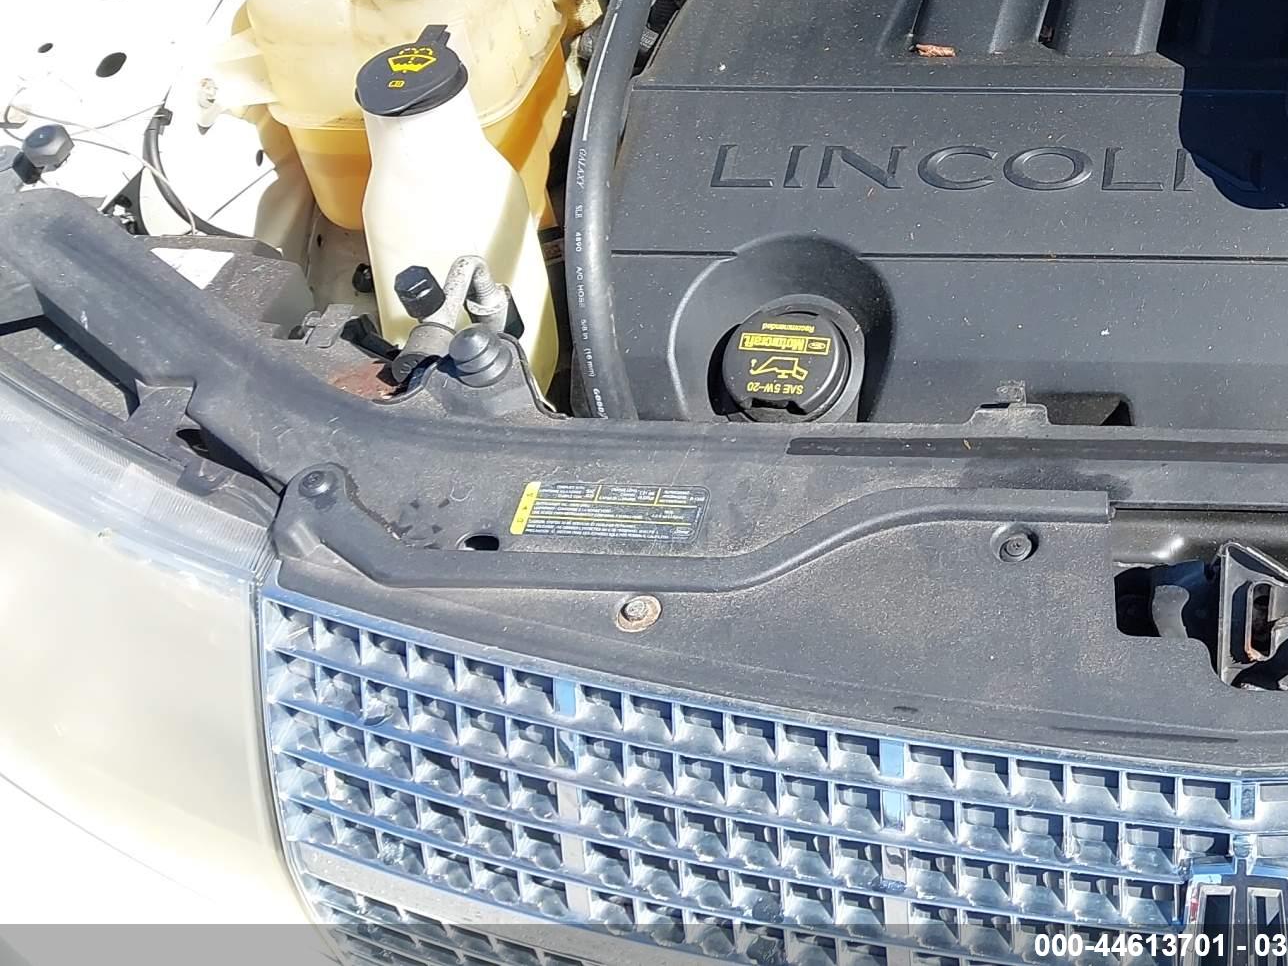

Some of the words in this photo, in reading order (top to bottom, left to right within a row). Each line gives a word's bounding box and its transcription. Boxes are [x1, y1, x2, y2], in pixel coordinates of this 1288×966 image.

[576, 148, 587, 189] GALAXY
[709, 144, 1264, 192] LINCOLN
[762, 322, 815, 333] Recommended
[744, 335, 805, 352] Motorcraft
[746, 382, 782, 394] 5W-20
[782, 384, 804, 395] SAE
